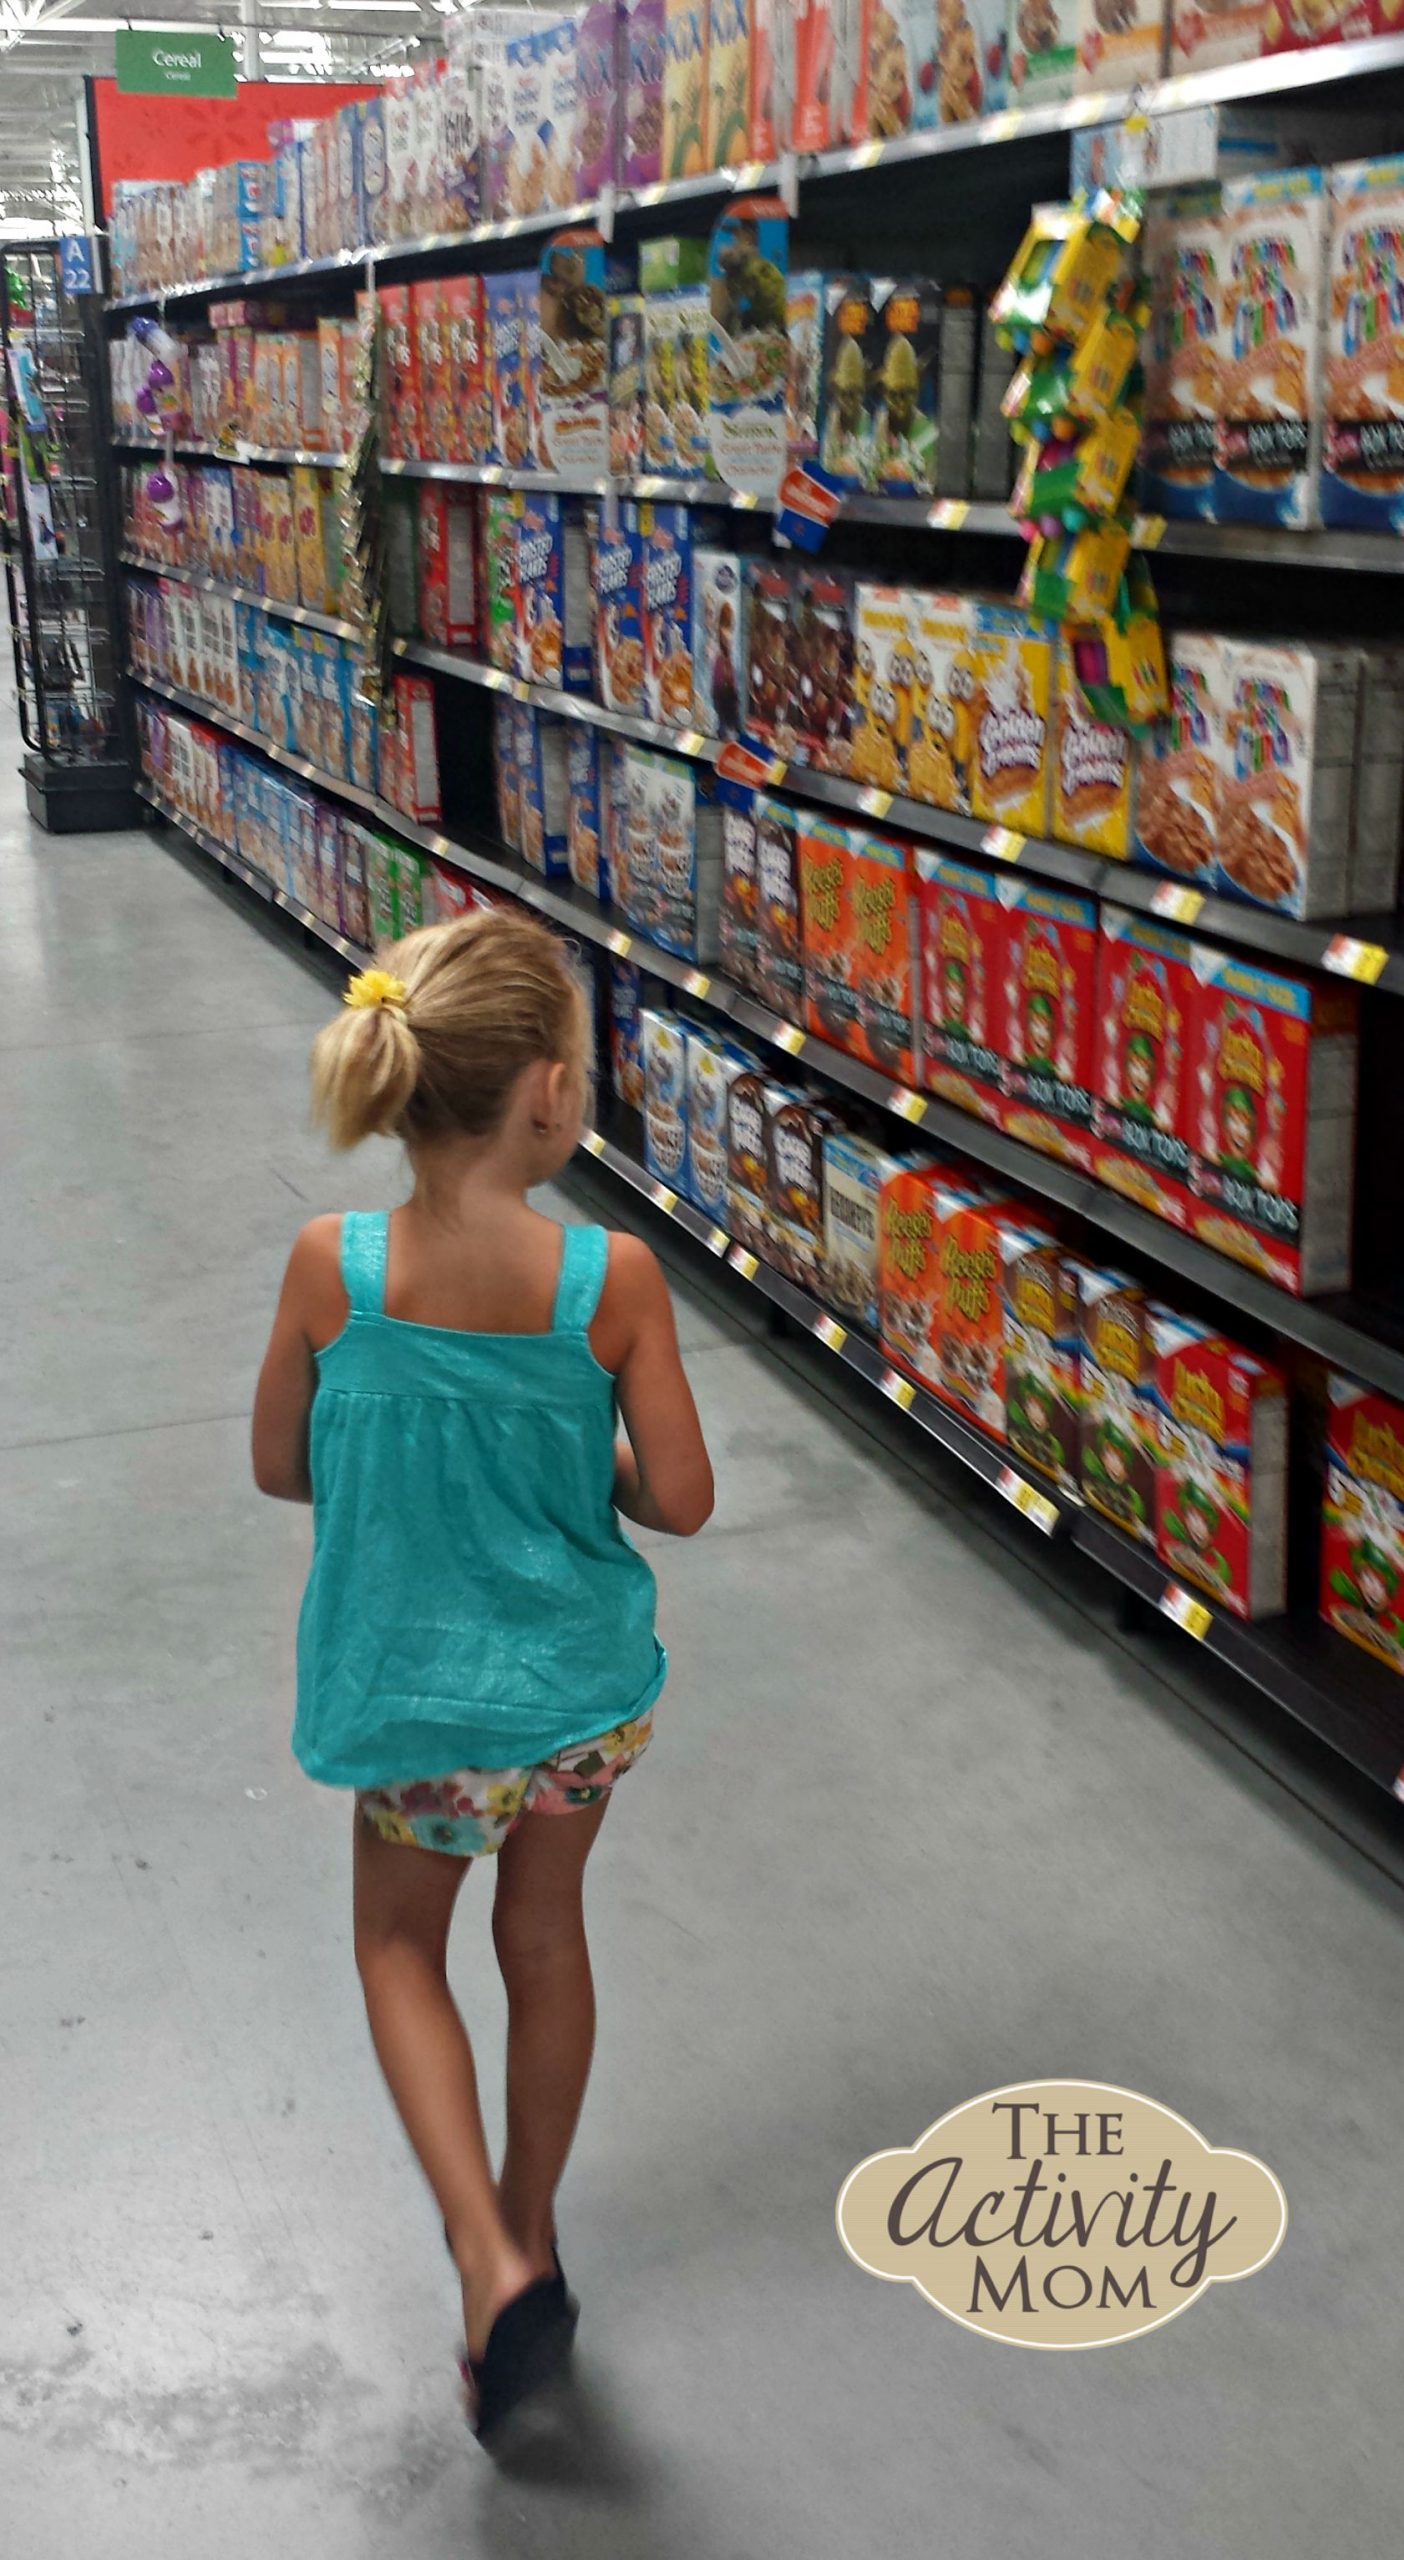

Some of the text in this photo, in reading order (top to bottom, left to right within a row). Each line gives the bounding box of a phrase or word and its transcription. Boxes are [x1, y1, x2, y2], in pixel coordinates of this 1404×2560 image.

[152, 49, 202, 69] Cereal
[66, 238, 86, 263] A
[63, 267, 92, 289] 22
